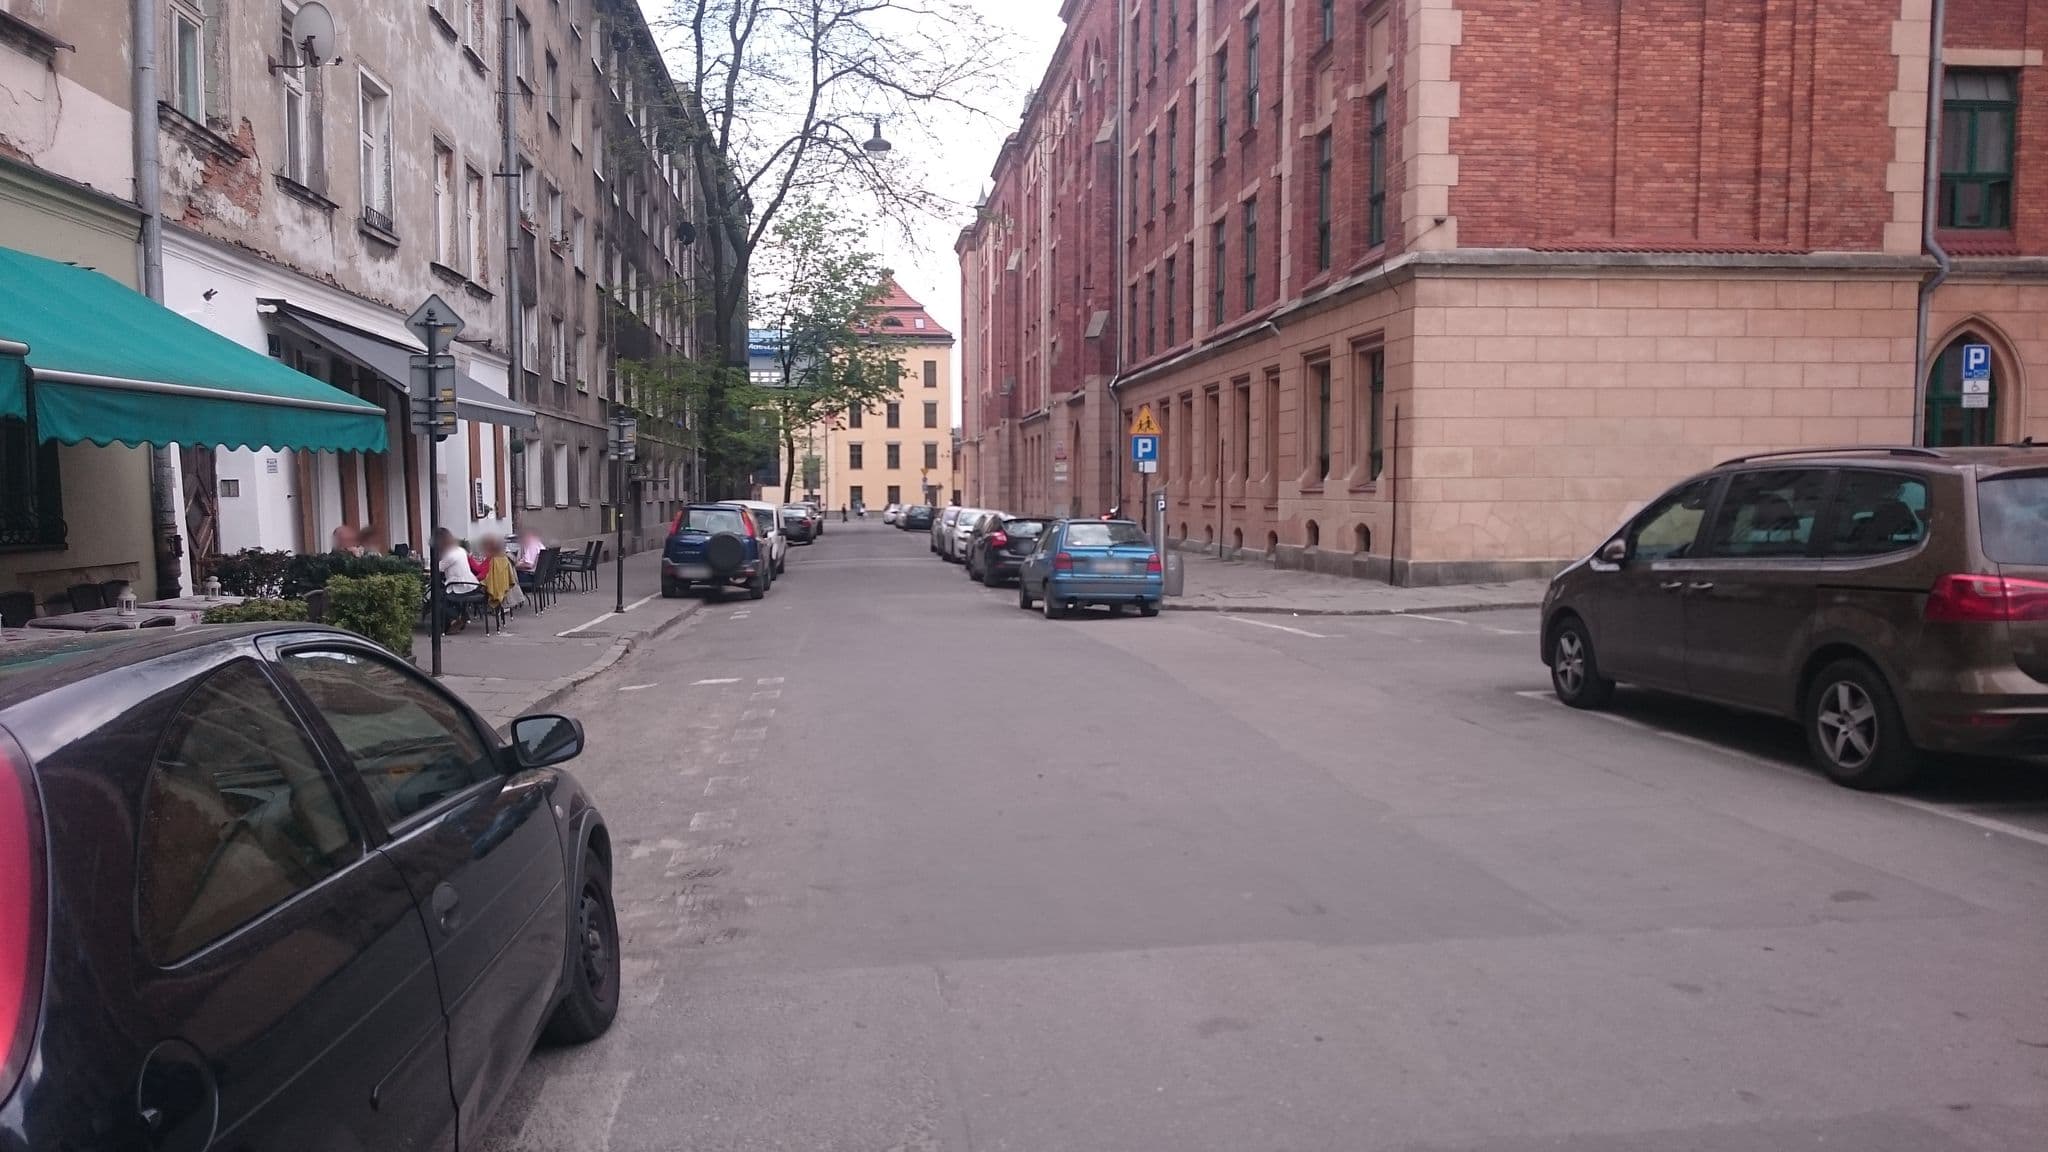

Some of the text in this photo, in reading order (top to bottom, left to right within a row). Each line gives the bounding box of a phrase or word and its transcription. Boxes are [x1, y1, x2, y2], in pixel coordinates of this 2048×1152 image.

[1969, 348, 1985, 370] P
[1137, 438, 1152, 458] P
[1158, 501, 1165, 511] P
